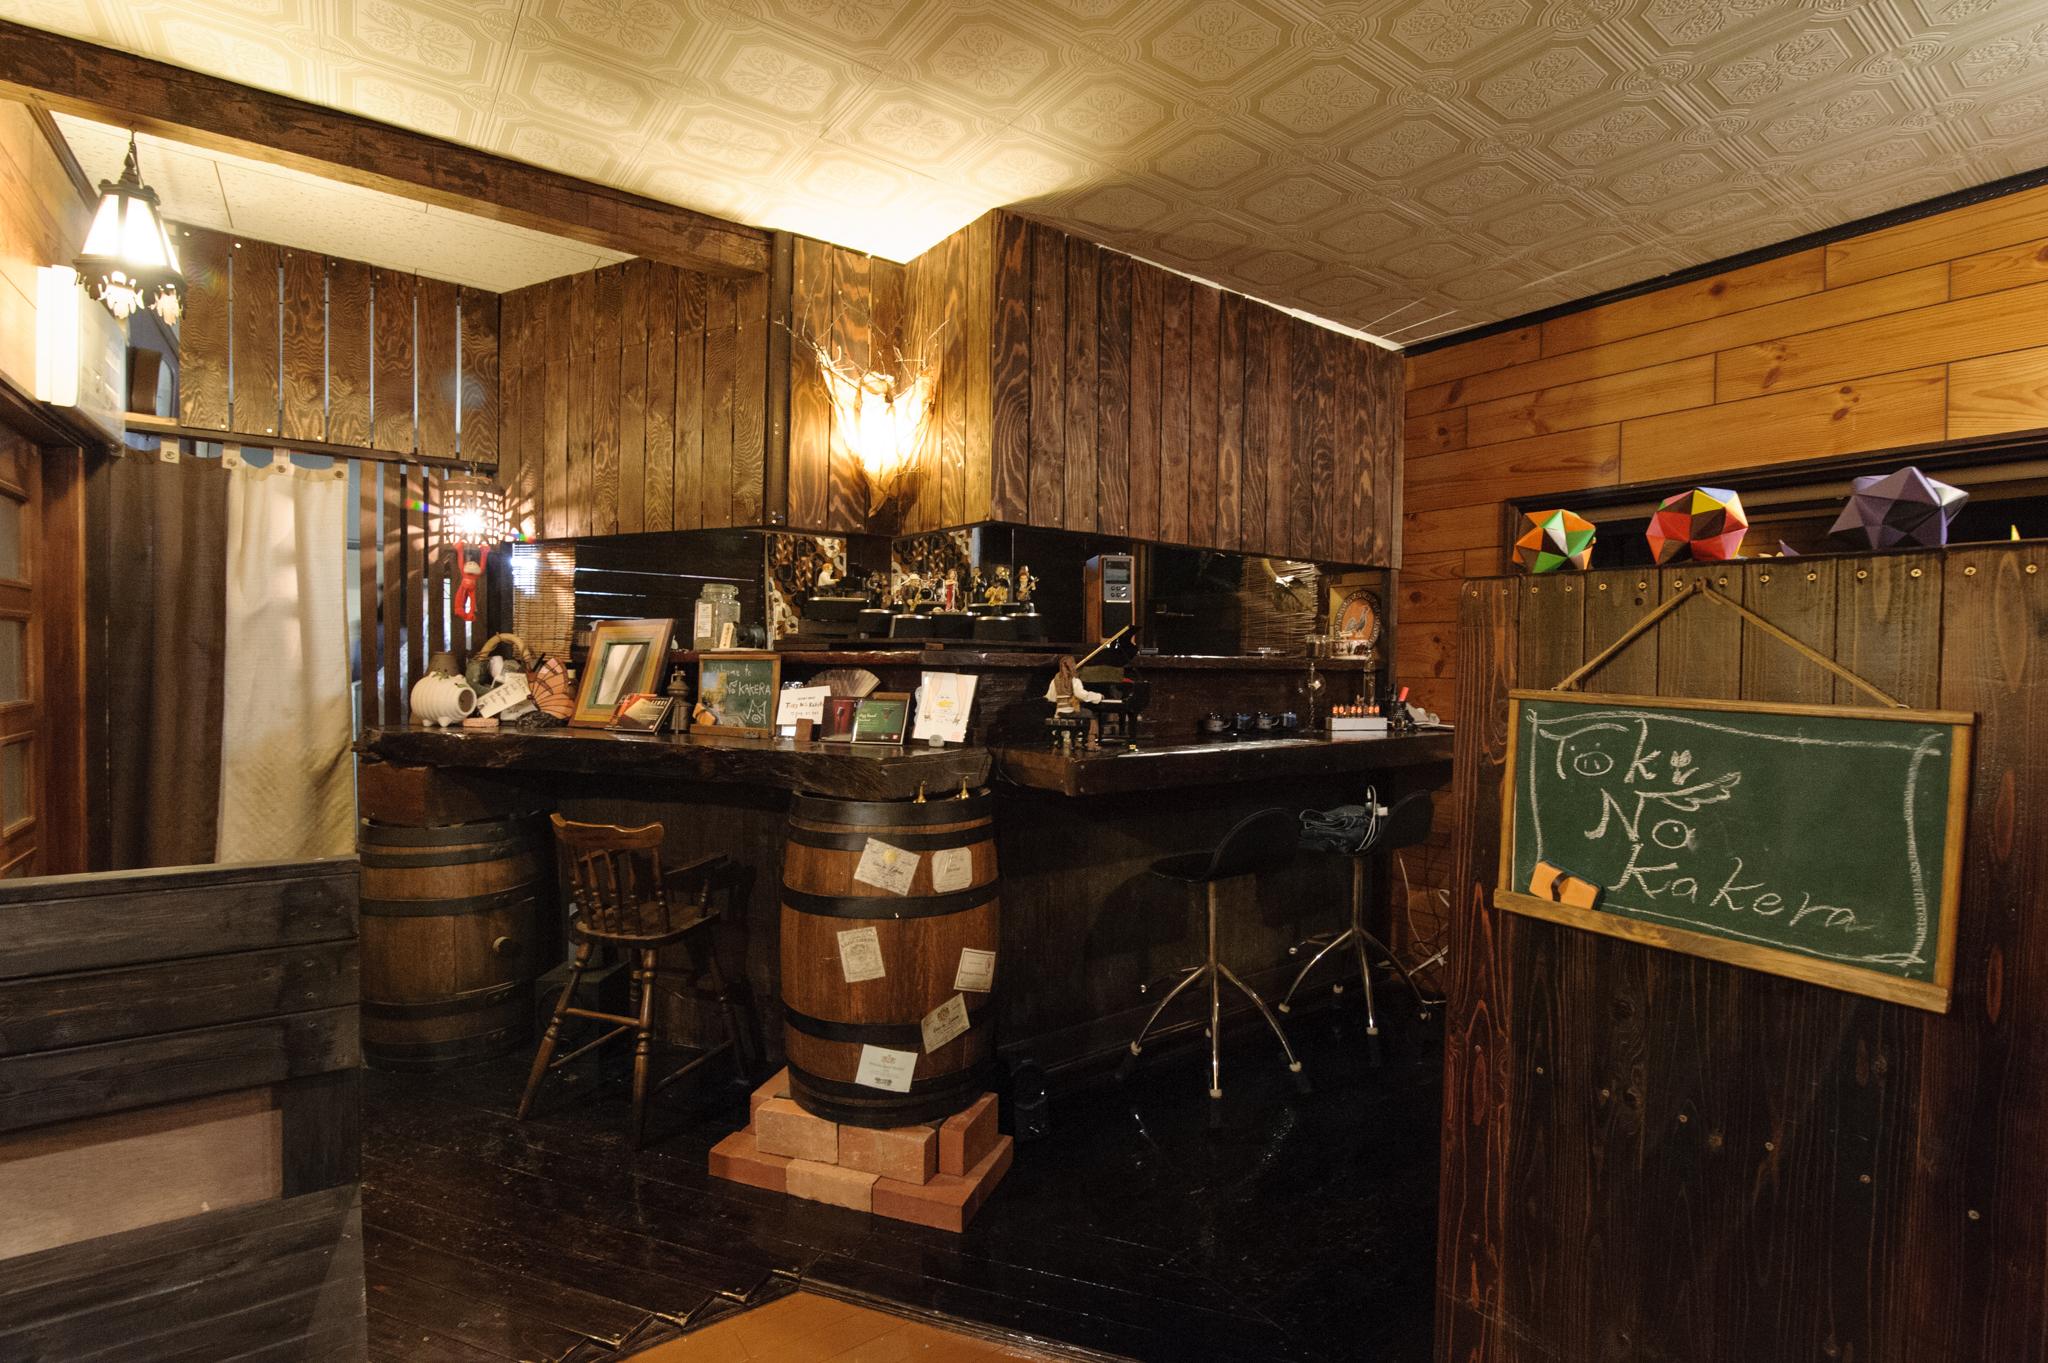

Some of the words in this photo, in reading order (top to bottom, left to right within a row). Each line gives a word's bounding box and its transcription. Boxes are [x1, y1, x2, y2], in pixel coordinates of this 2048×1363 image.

[738, 680, 771, 697] KAKERA
[1583, 772, 1736, 849] No
[1607, 844, 1870, 933] Kakera
